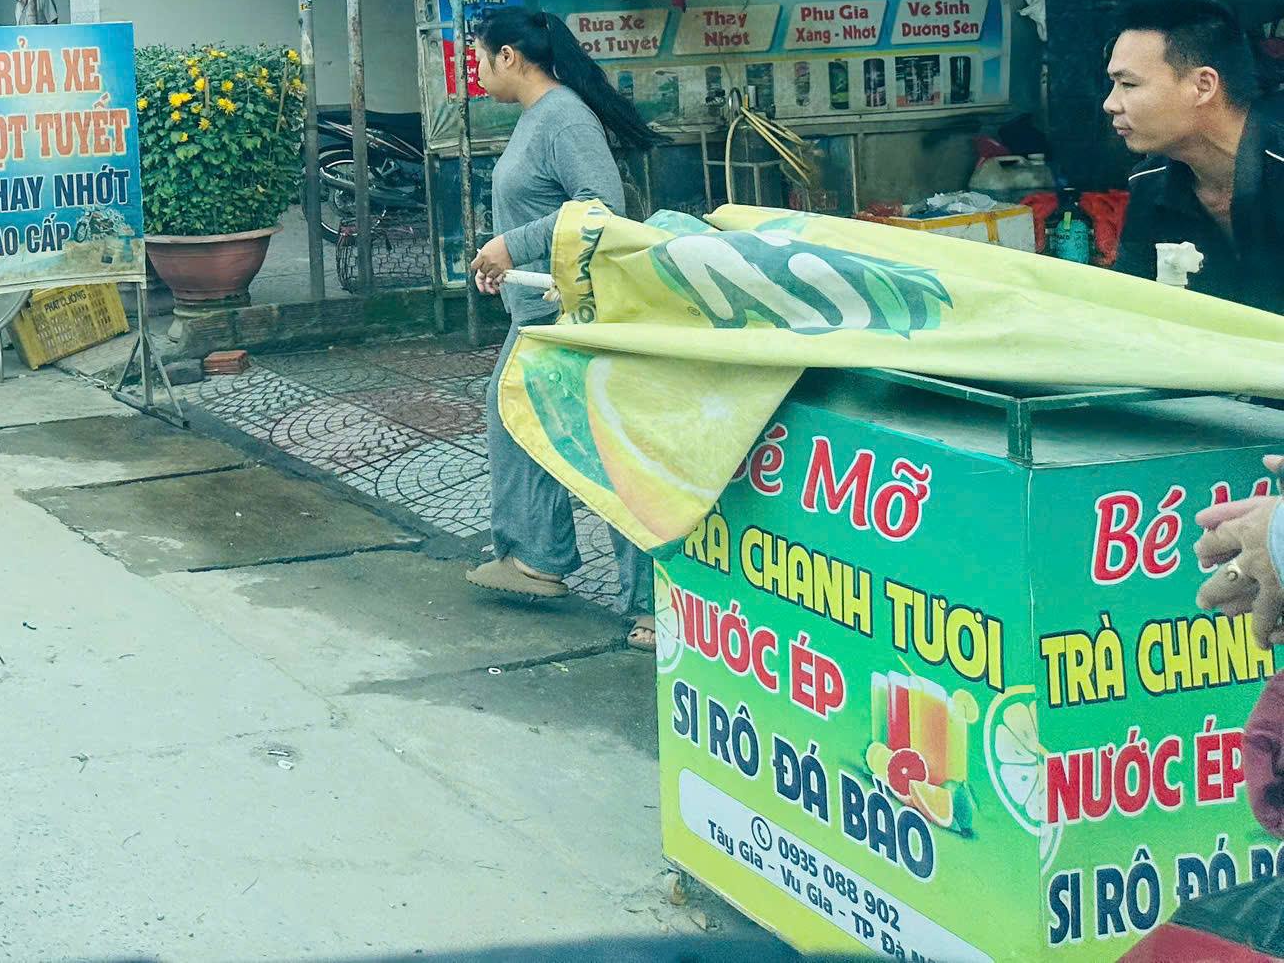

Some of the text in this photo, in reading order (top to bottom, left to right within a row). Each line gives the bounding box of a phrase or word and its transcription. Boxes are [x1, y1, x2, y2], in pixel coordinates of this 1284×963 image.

[619, 14, 645, 31] Xe
[703, 10, 748, 28] Thay
[839, 5, 869, 20] Gia
[935, 0, 970, 16] Sinh
[61, 47, 101, 92] XE
[35, 93, 131, 158] TUYẾT
[26, 213, 72, 254] CẤP
[53, 164, 130, 209] NHỚT
[730, 423, 933, 542] é Mỡ
[1091, 485, 1186, 586] Bé
[670, 584, 847, 719] NƯỚC ÉP
[739, 524, 874, 638] CHANH
[884, 577, 1006, 694] TƯƠI
[1040, 610, 1127, 708] TRÀ
[672, 679, 937, 883] SI RÔ ĐÁ BÀO
[1046, 714, 1246, 825] NƯỚC ÉP
[707, 819, 735, 856] Tây
[738, 840, 764, 872] Gia
[781, 865, 803, 895] Vu
[806, 882, 834, 917] Gia
[851, 910, 875, 940] TP
[777, 836, 902, 933] 0935 088 902
[1048, 870, 1084, 945] SI
[1095, 843, 1162, 939] RÔ
